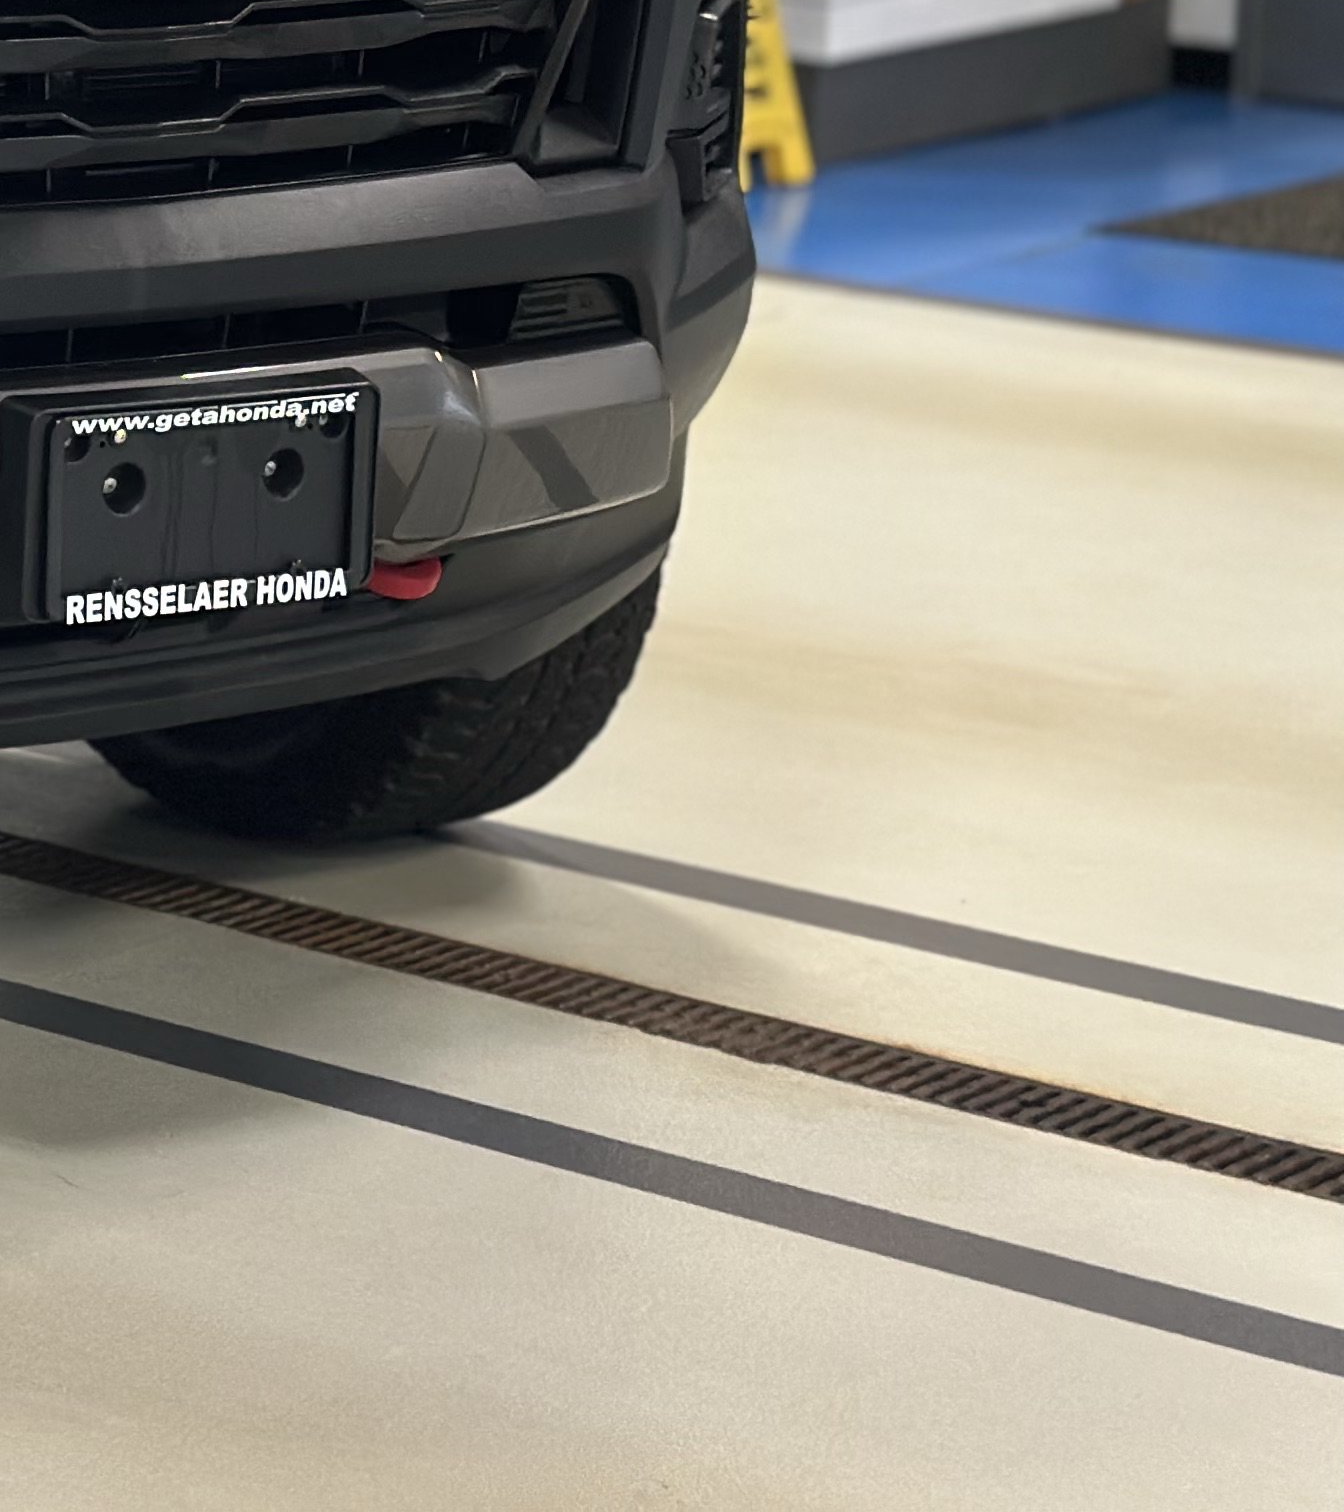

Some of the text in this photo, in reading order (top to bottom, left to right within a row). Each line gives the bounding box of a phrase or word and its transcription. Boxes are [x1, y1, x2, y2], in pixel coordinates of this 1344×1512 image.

[72, 392, 359, 435] www.getahonda.net
[66, 568, 347, 625] RENSSELAER HONDA
